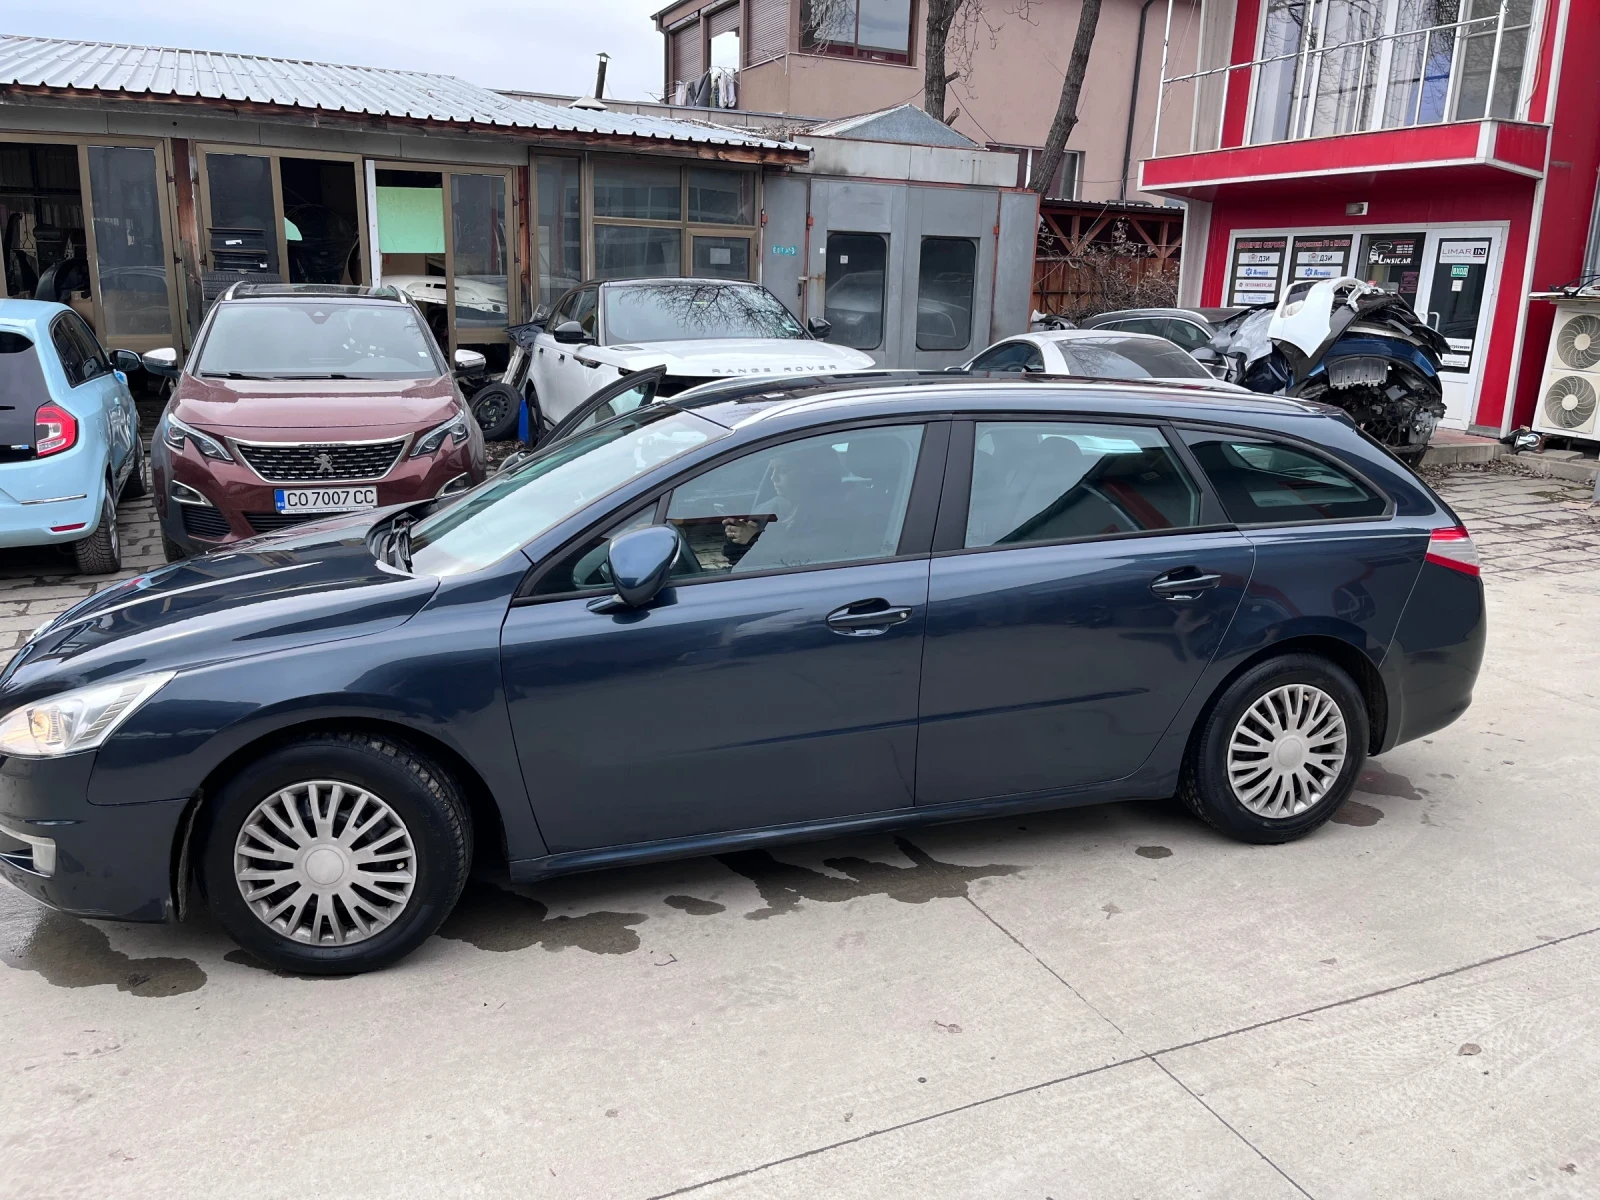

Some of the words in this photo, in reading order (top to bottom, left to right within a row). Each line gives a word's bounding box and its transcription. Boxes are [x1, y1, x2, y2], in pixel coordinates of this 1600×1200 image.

[1474, 247, 1487, 255] IN
[1258, 255, 1271, 263] ДЗИ
[1319, 254, 1333, 262] ДЗИ
[1452, 267, 1468, 275] ВХОД
[783, 364, 838, 372] ROVER
[287, 492, 309, 507] CO
[311, 490, 350, 506] 7007
[353, 489, 375, 504] CC
